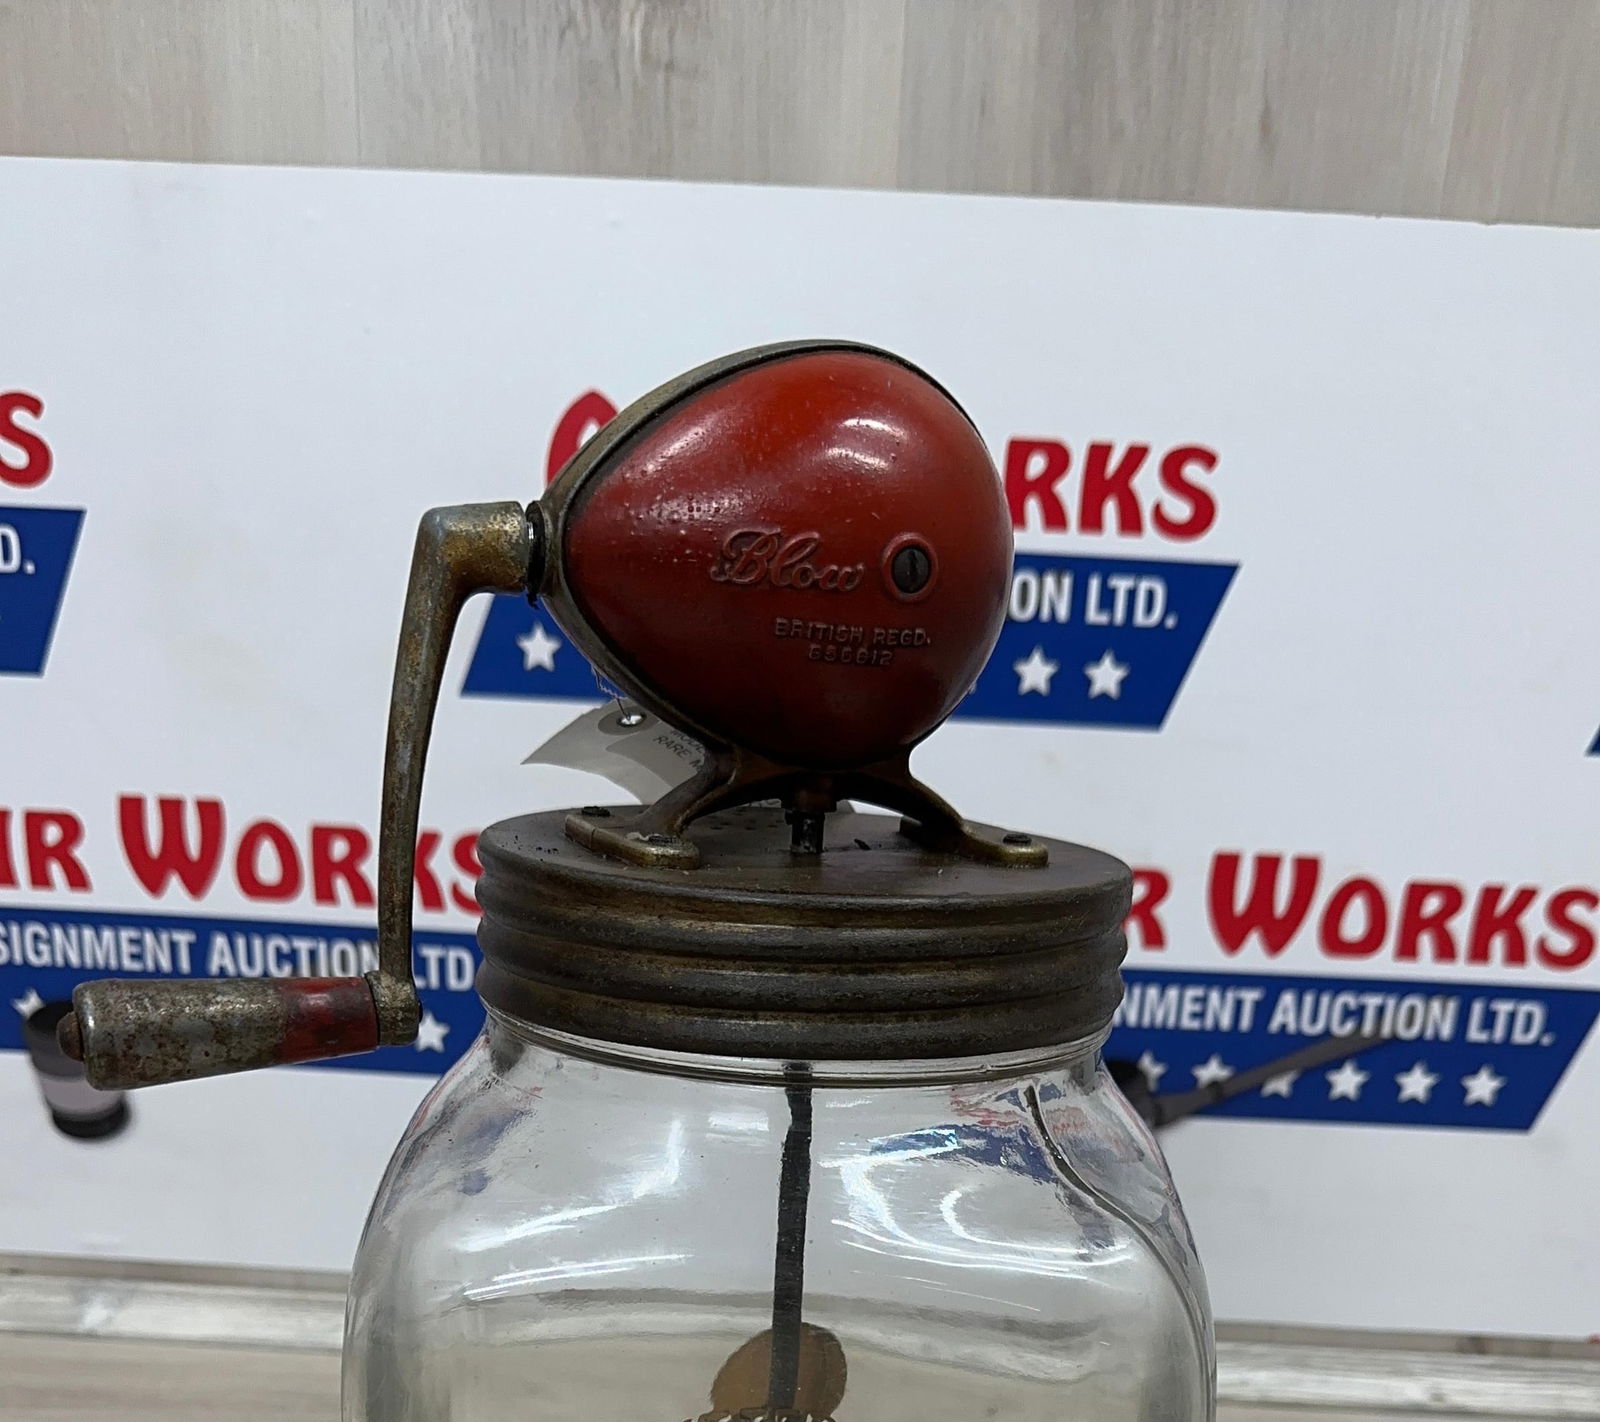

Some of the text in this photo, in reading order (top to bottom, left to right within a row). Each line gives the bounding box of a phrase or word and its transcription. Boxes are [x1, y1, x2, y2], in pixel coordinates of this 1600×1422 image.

[710, 525, 865, 591] Blow
[1085, 571, 1178, 629] LTD.
[774, 617, 931, 646] BRITISH REGD.
[1206, 848, 1600, 973] WORKS
[1266, 990, 1458, 1042] AUCTION
[1465, 998, 1556, 1047] LTD.
